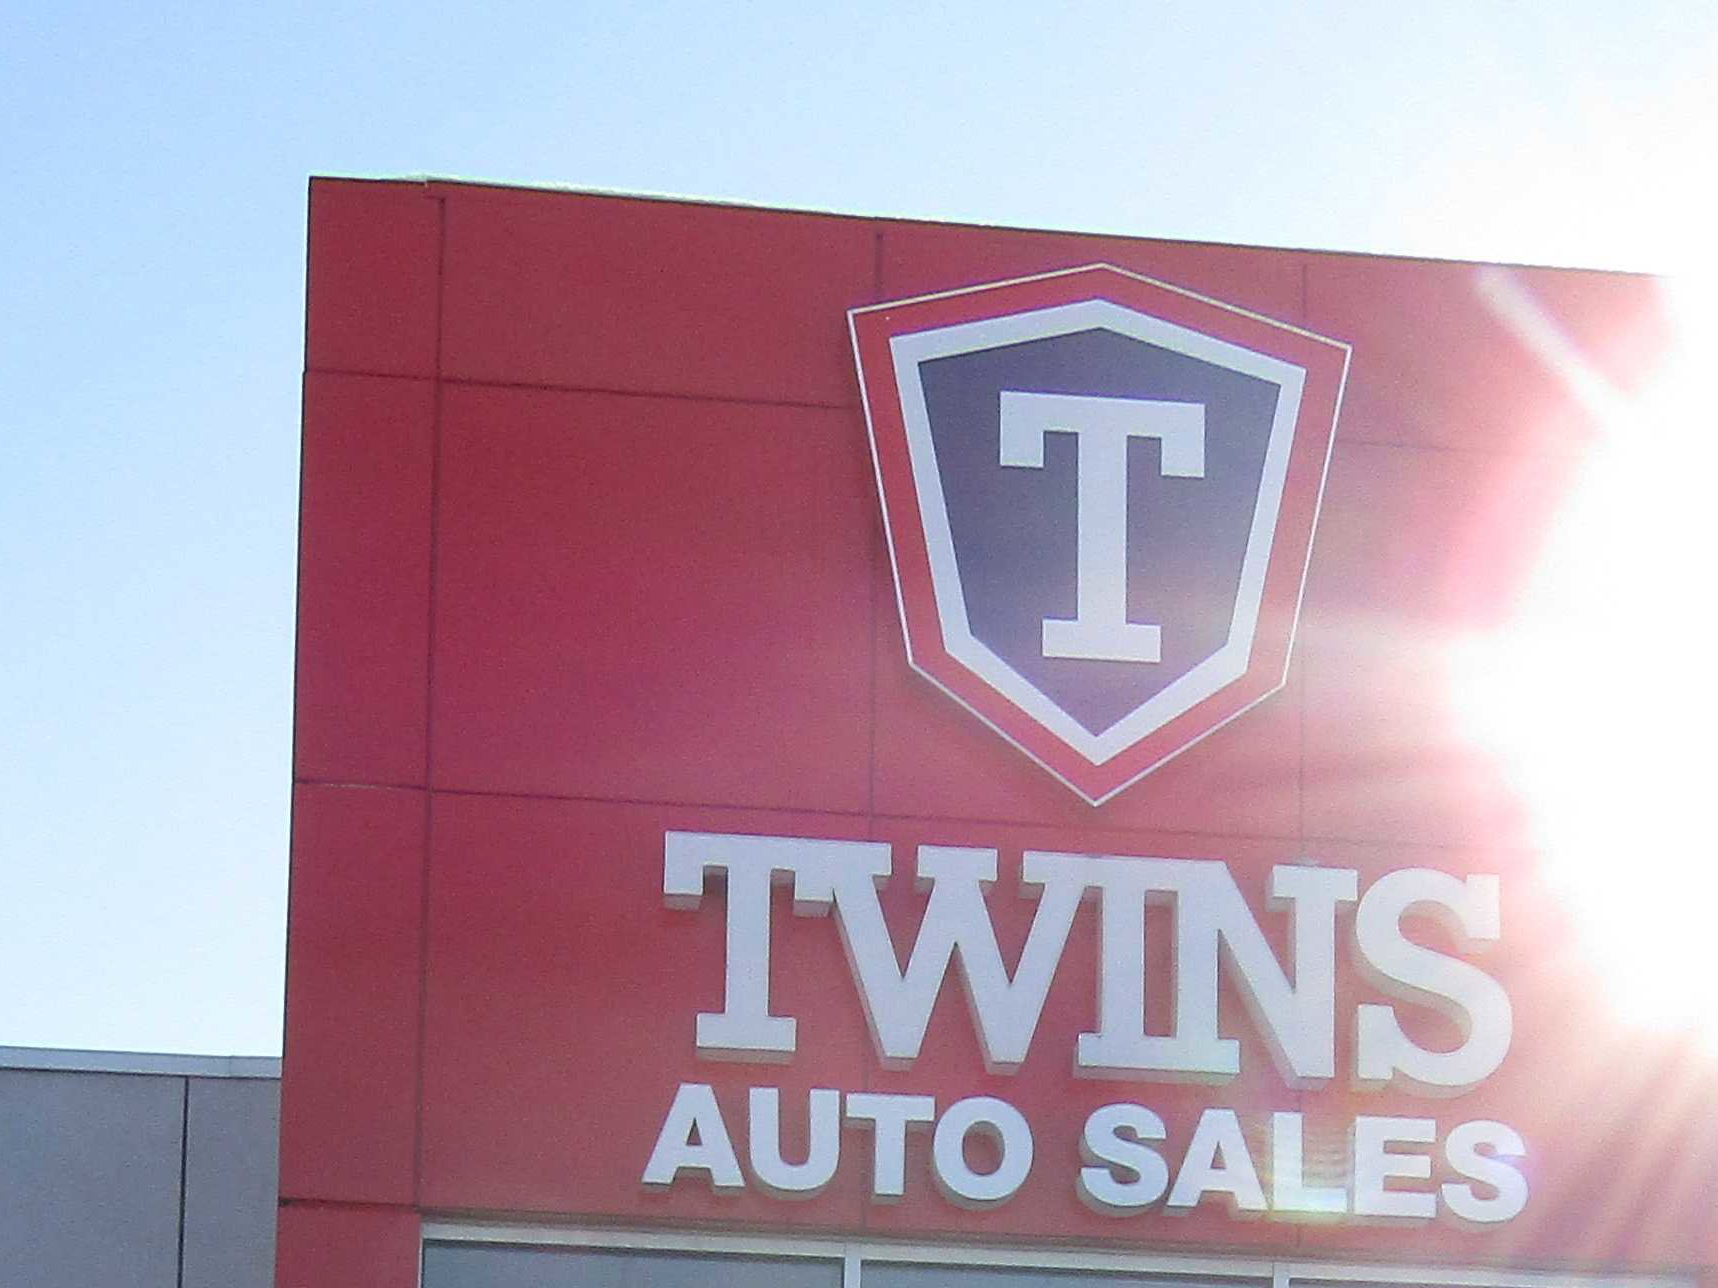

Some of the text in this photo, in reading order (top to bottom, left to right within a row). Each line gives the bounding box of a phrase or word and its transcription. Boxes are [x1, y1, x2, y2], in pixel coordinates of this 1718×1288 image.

[999, 391, 1205, 662] T
[663, 830, 1513, 1093] TWINS
[641, 1083, 1529, 1224] AUTO SALES
